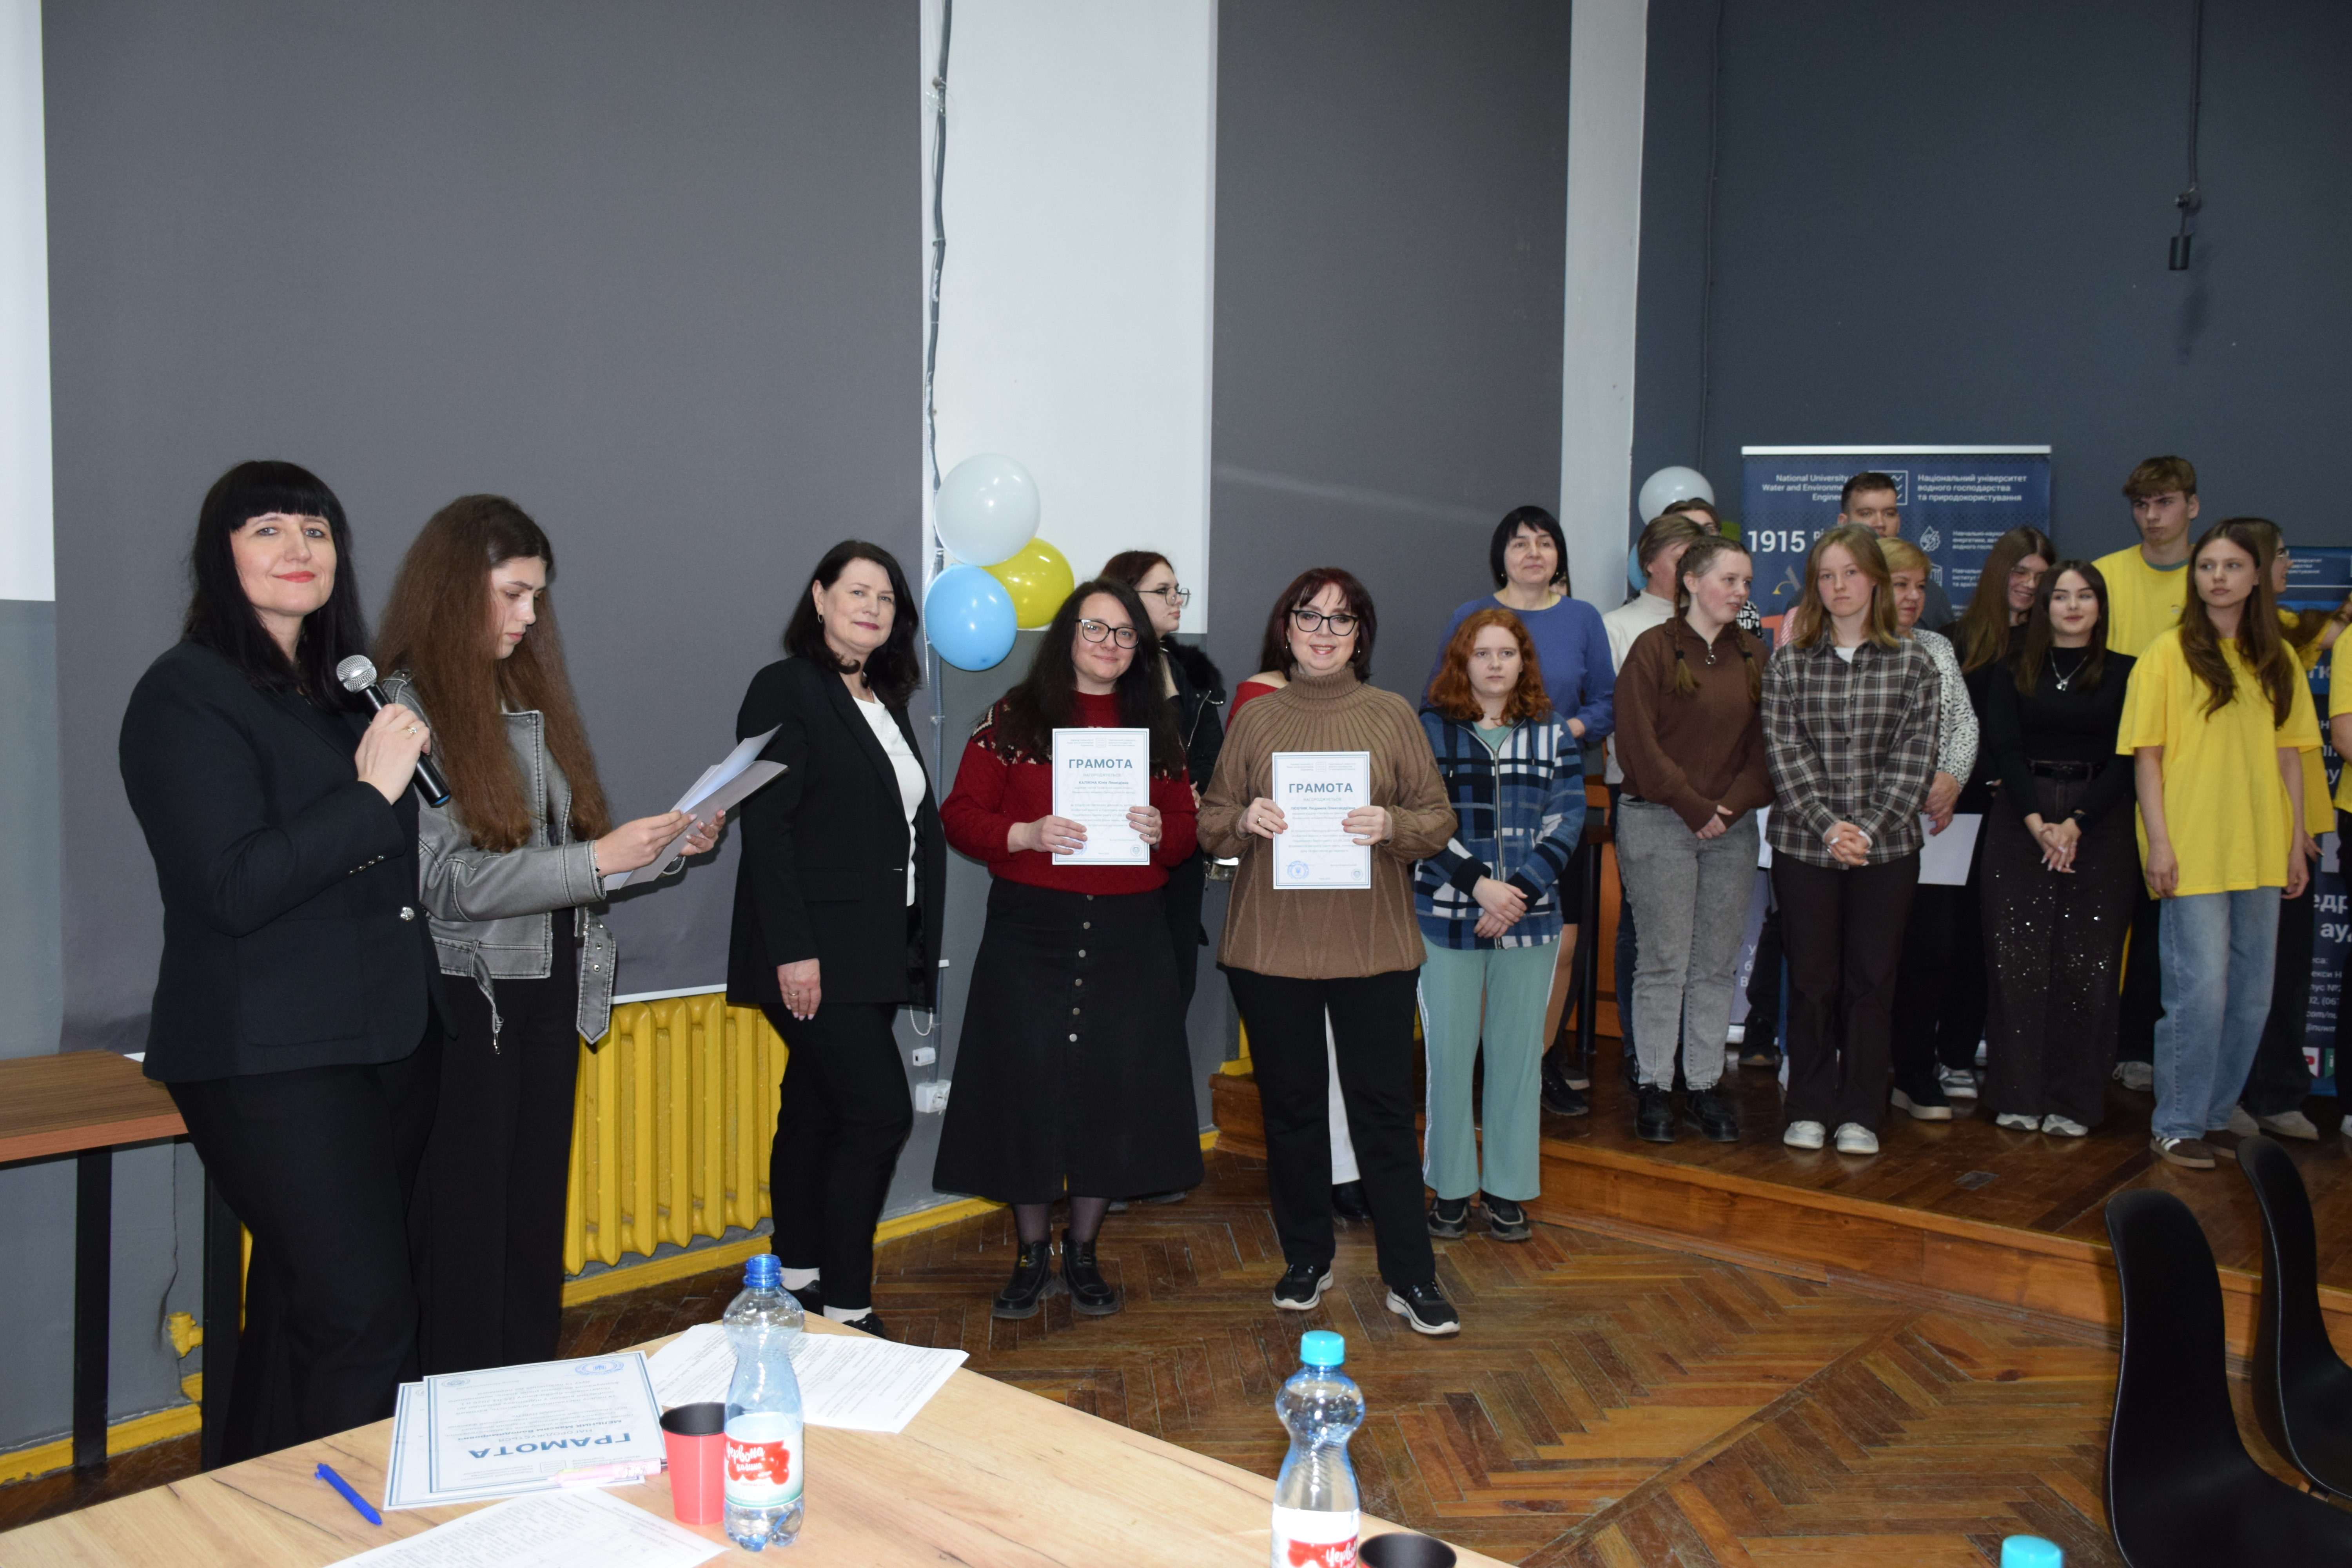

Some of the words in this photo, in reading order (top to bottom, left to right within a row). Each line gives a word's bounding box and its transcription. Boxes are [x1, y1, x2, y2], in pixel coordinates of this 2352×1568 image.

[1810, 474, 1848, 483] University
[1918, 474, 1976, 483] Національний
[1977, 475, 2027, 483] університет
[1929, 494, 2022, 503] природокористування
[1748, 530, 1806, 553] 1915
[1069, 759, 1132, 769] ГРАМОТА
[1289, 783, 1353, 793] ГРАМОТА
[468, 1432, 631, 1459] ГРАМОТА
[726, 1441, 765, 1464] Червона
[737, 1463, 762, 1472] калина
